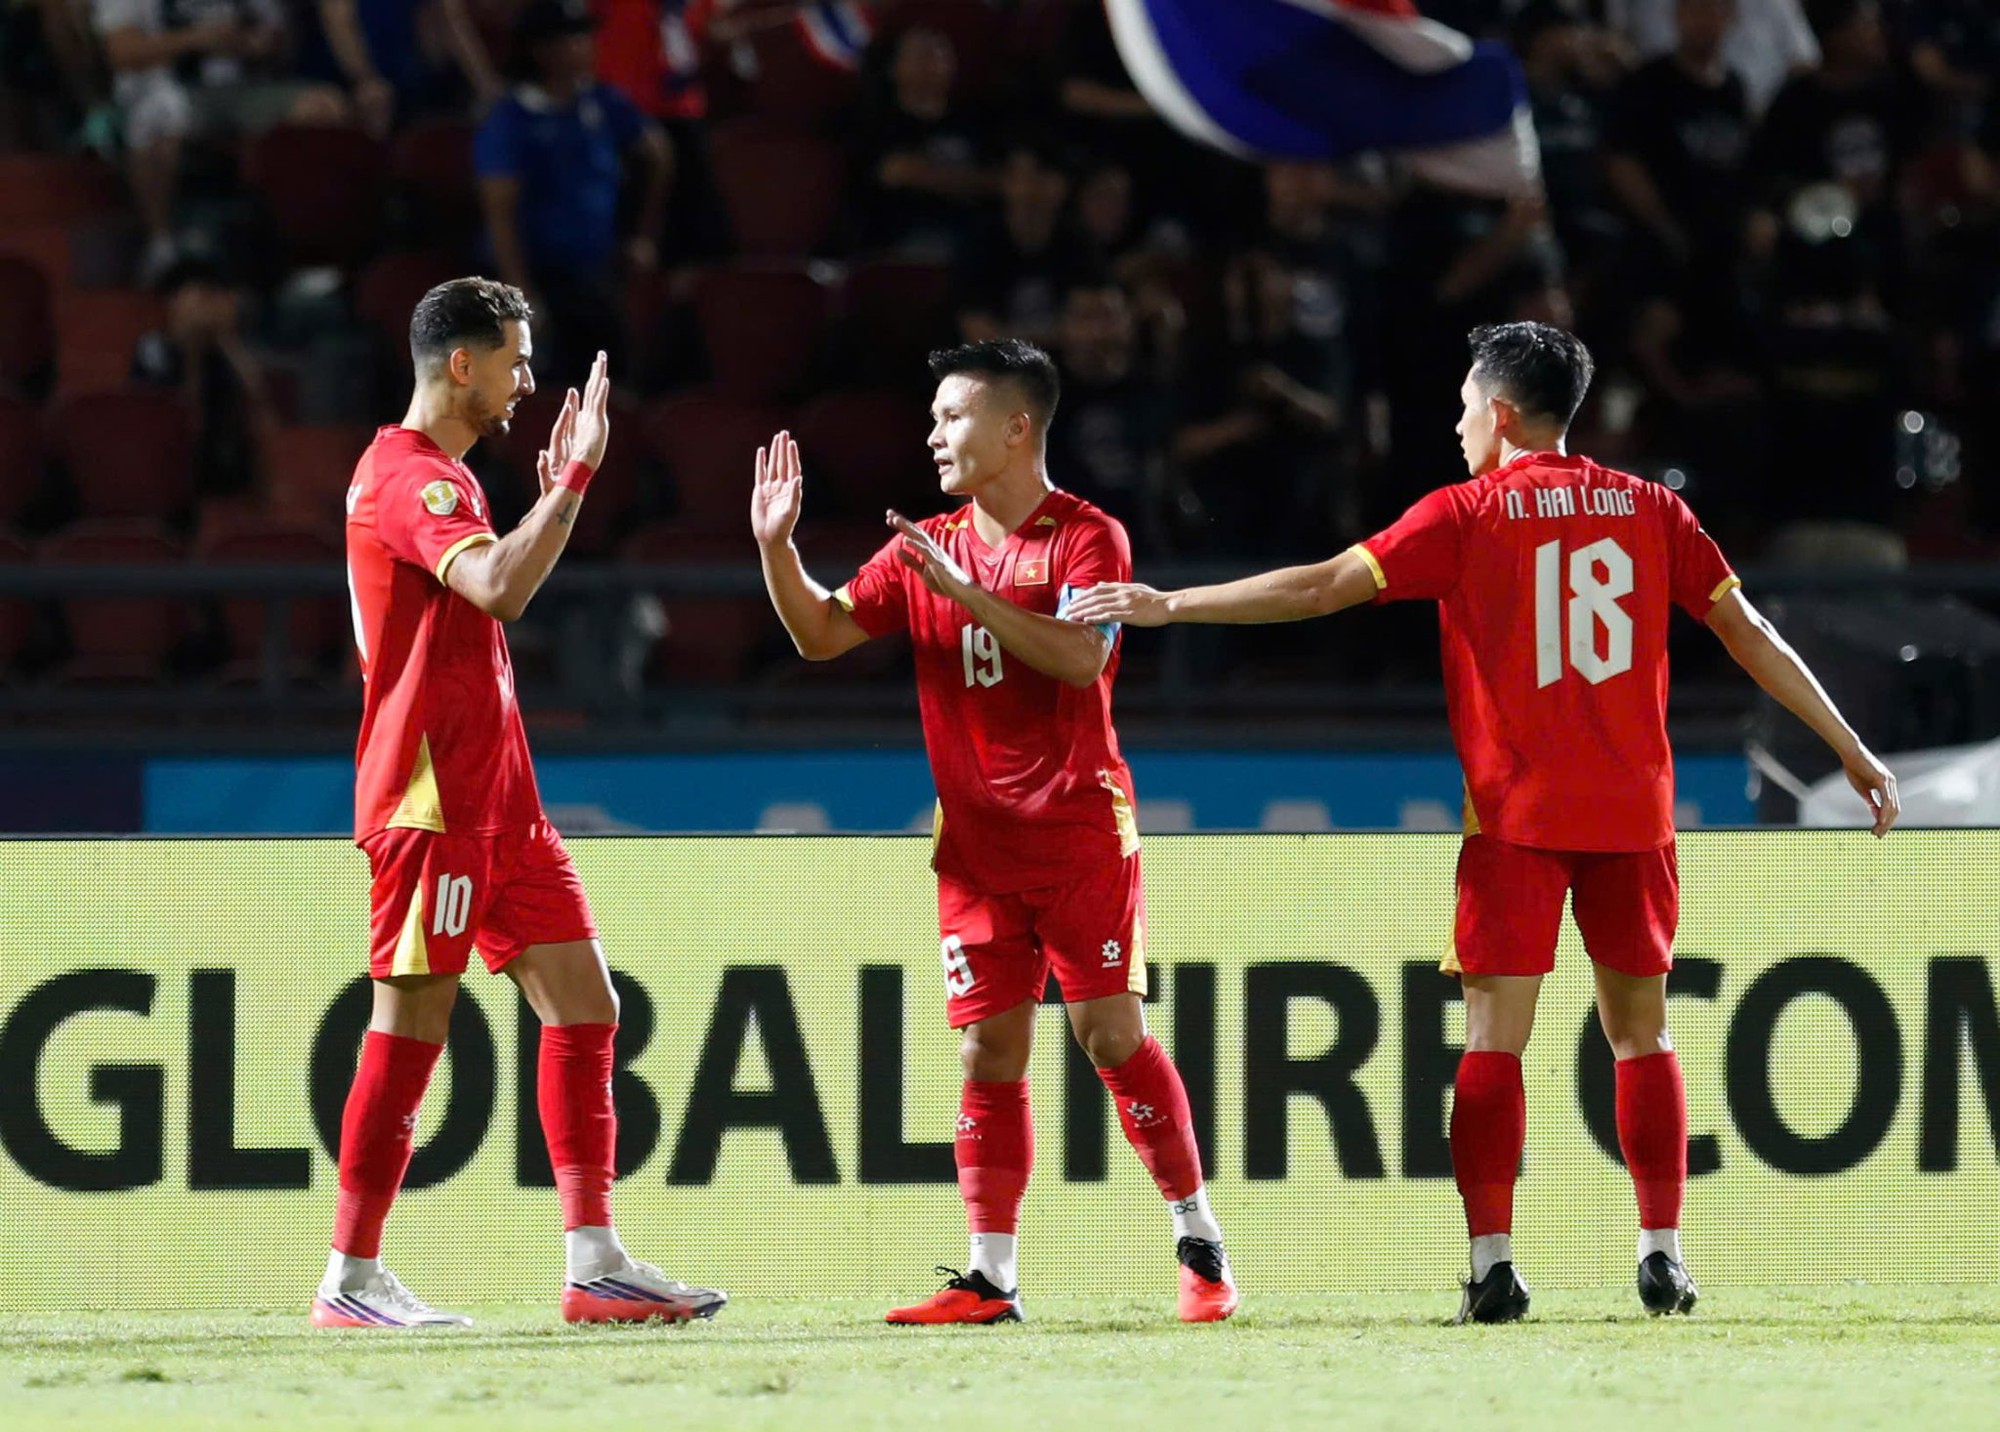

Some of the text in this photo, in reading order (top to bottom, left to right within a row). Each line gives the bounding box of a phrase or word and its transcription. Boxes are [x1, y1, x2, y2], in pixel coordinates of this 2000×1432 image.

[1535, 485, 1575, 518] HAI
[1580, 485, 1636, 516] LONG
[1535, 537, 1634, 689] 18
[962, 623, 1003, 688] 19
[433, 873, 472, 937] 10
[0, 964, 957, 1193] GLOBAL
